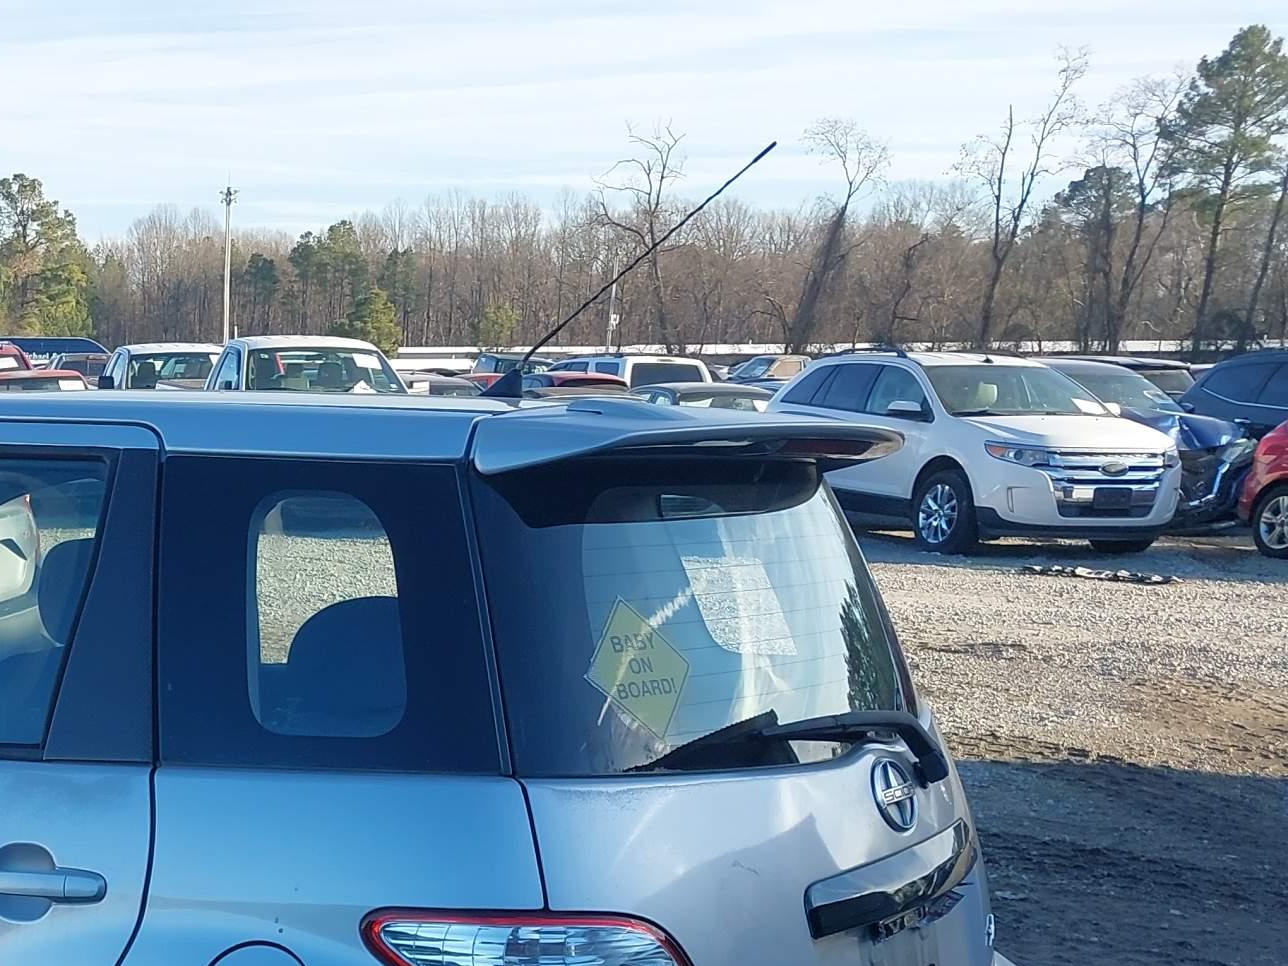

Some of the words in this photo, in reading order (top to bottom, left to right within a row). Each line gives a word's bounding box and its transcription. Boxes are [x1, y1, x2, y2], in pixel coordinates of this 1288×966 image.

[609, 631, 655, 653] BABY
[628, 656, 654, 674] ON
[616, 677, 678, 700] BOARD!
